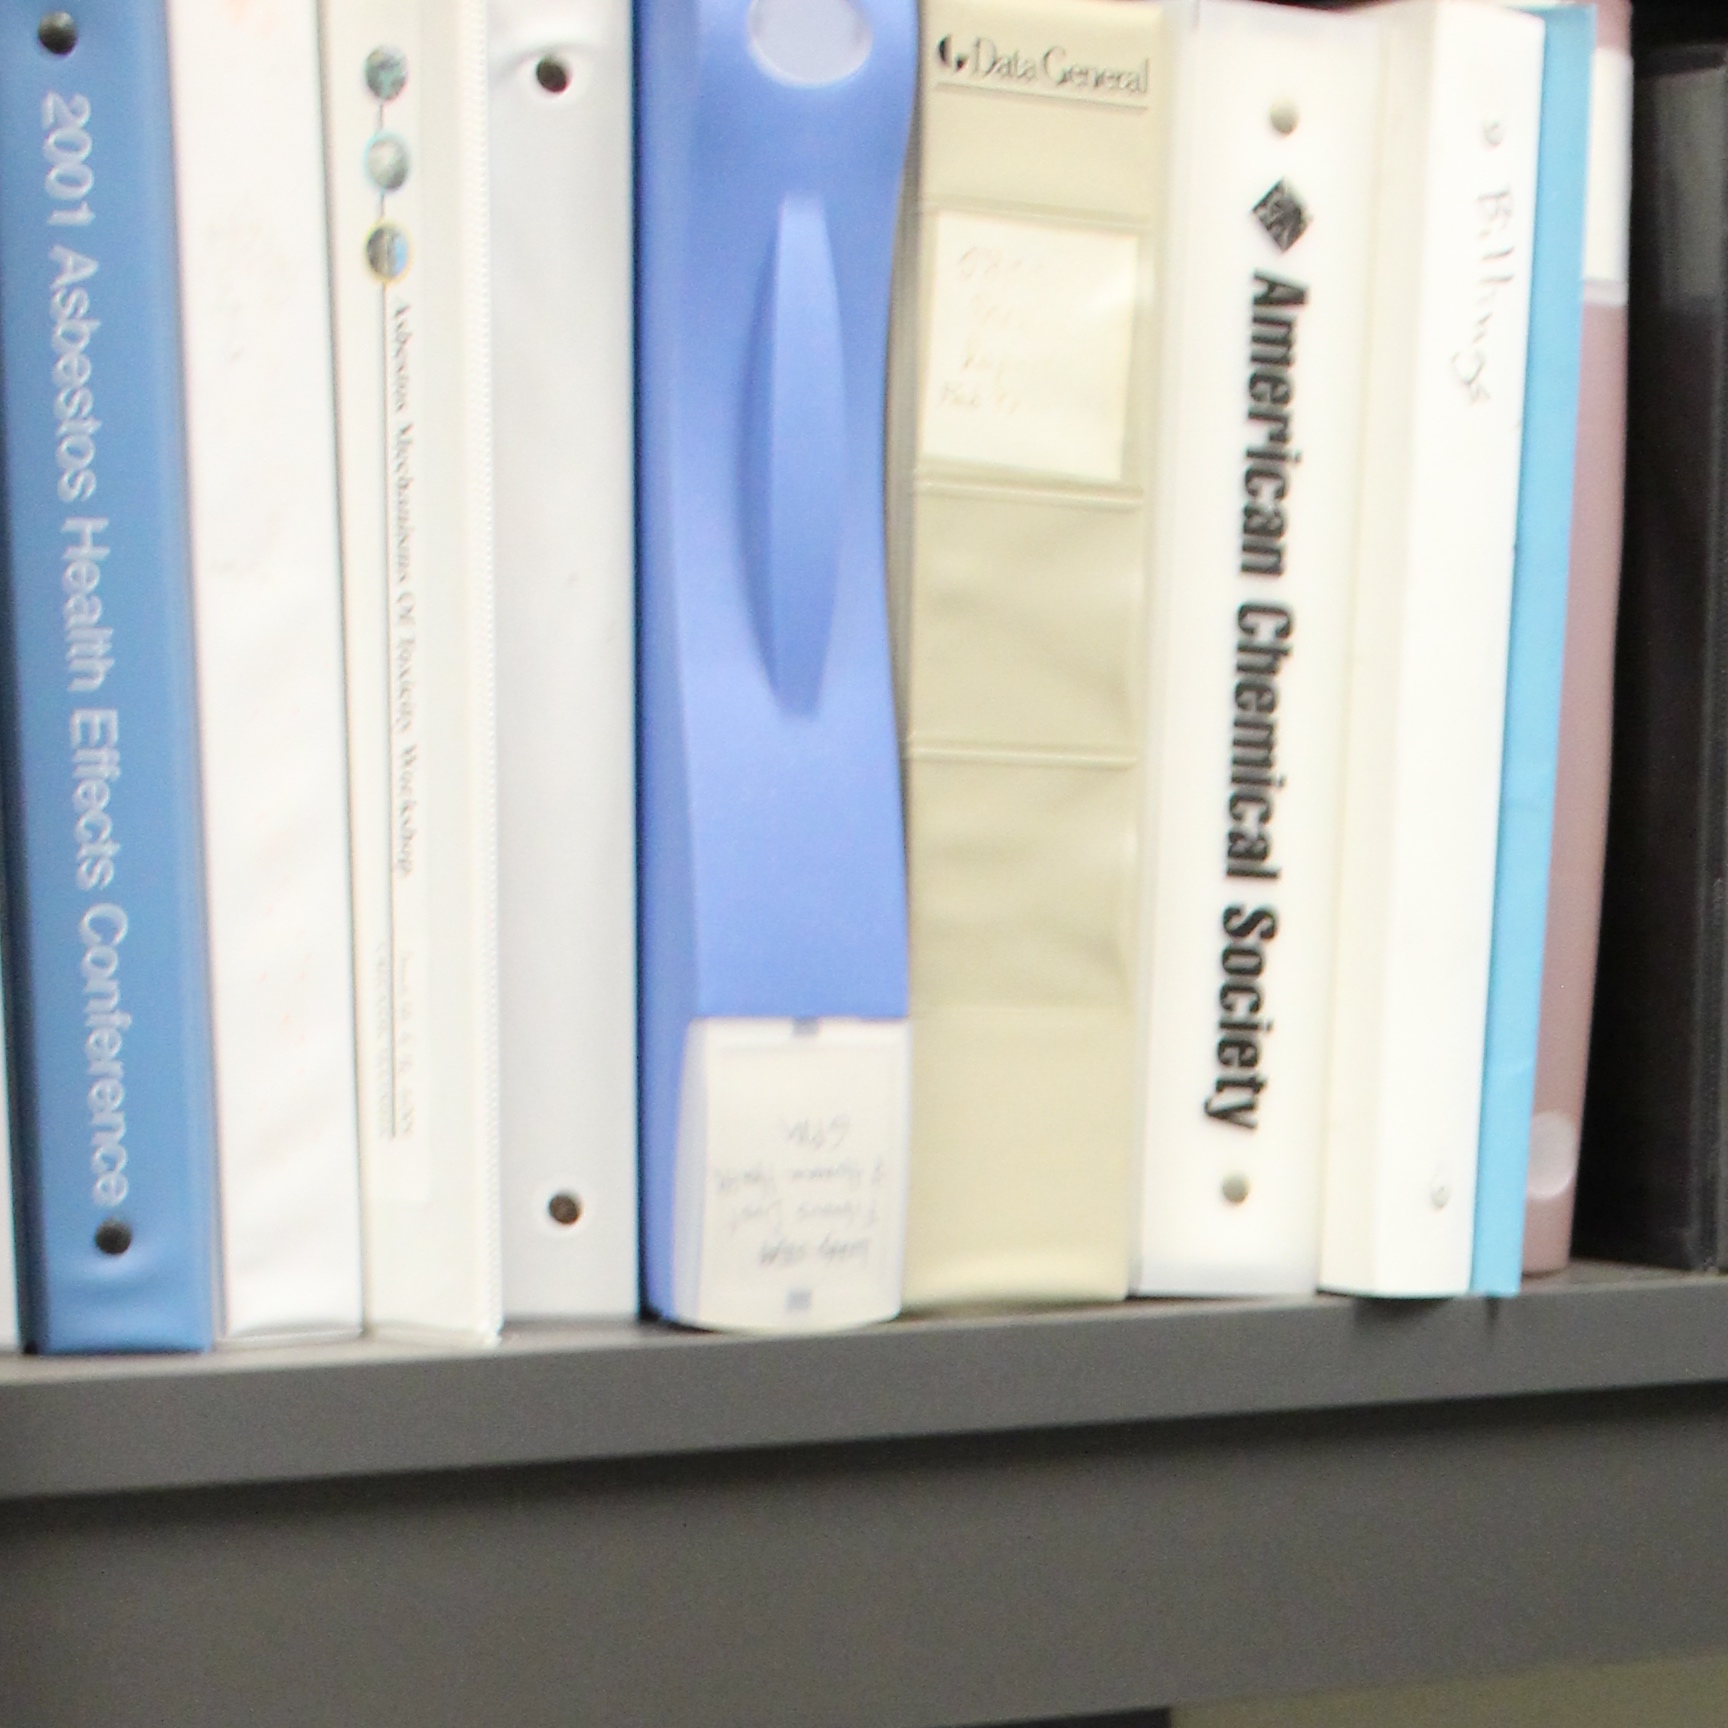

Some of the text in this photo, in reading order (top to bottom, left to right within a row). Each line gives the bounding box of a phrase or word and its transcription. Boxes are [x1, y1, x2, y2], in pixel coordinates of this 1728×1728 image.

[972, 36, 1151, 97] Data General
[393, 300, 416, 414] Asbestos
[393, 421, 418, 586] Mechanisms
[40, 92, 133, 1208] 2001 Asbestos Health Effects Conference
[392, 634, 420, 734] Toxicity
[1200, 270, 1310, 1135] American Chemical Society
[394, 744, 420, 878] Workshop
